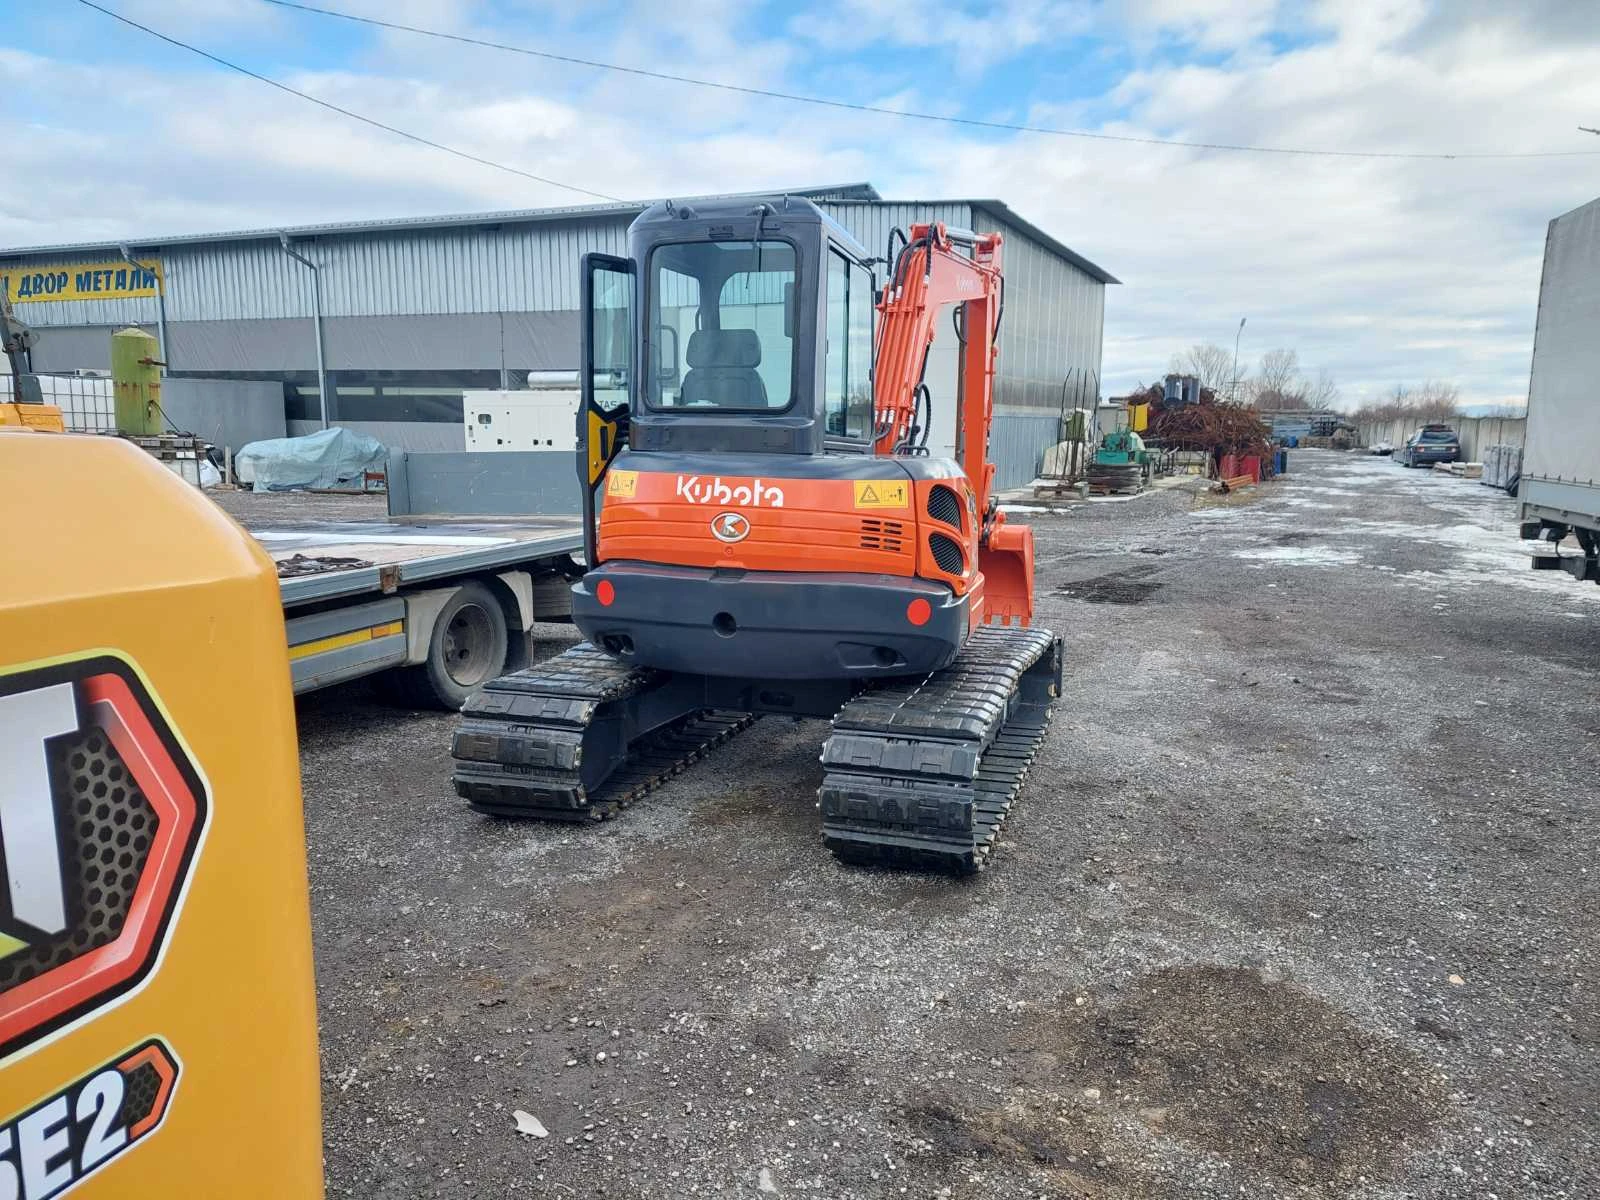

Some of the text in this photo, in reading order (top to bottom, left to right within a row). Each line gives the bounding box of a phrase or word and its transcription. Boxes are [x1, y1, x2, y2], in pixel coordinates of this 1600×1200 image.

[18, 271, 69, 298] ДВОР
[75, 267, 156, 293] МЕТАЛИ
[676, 475, 785, 508] Kubota
